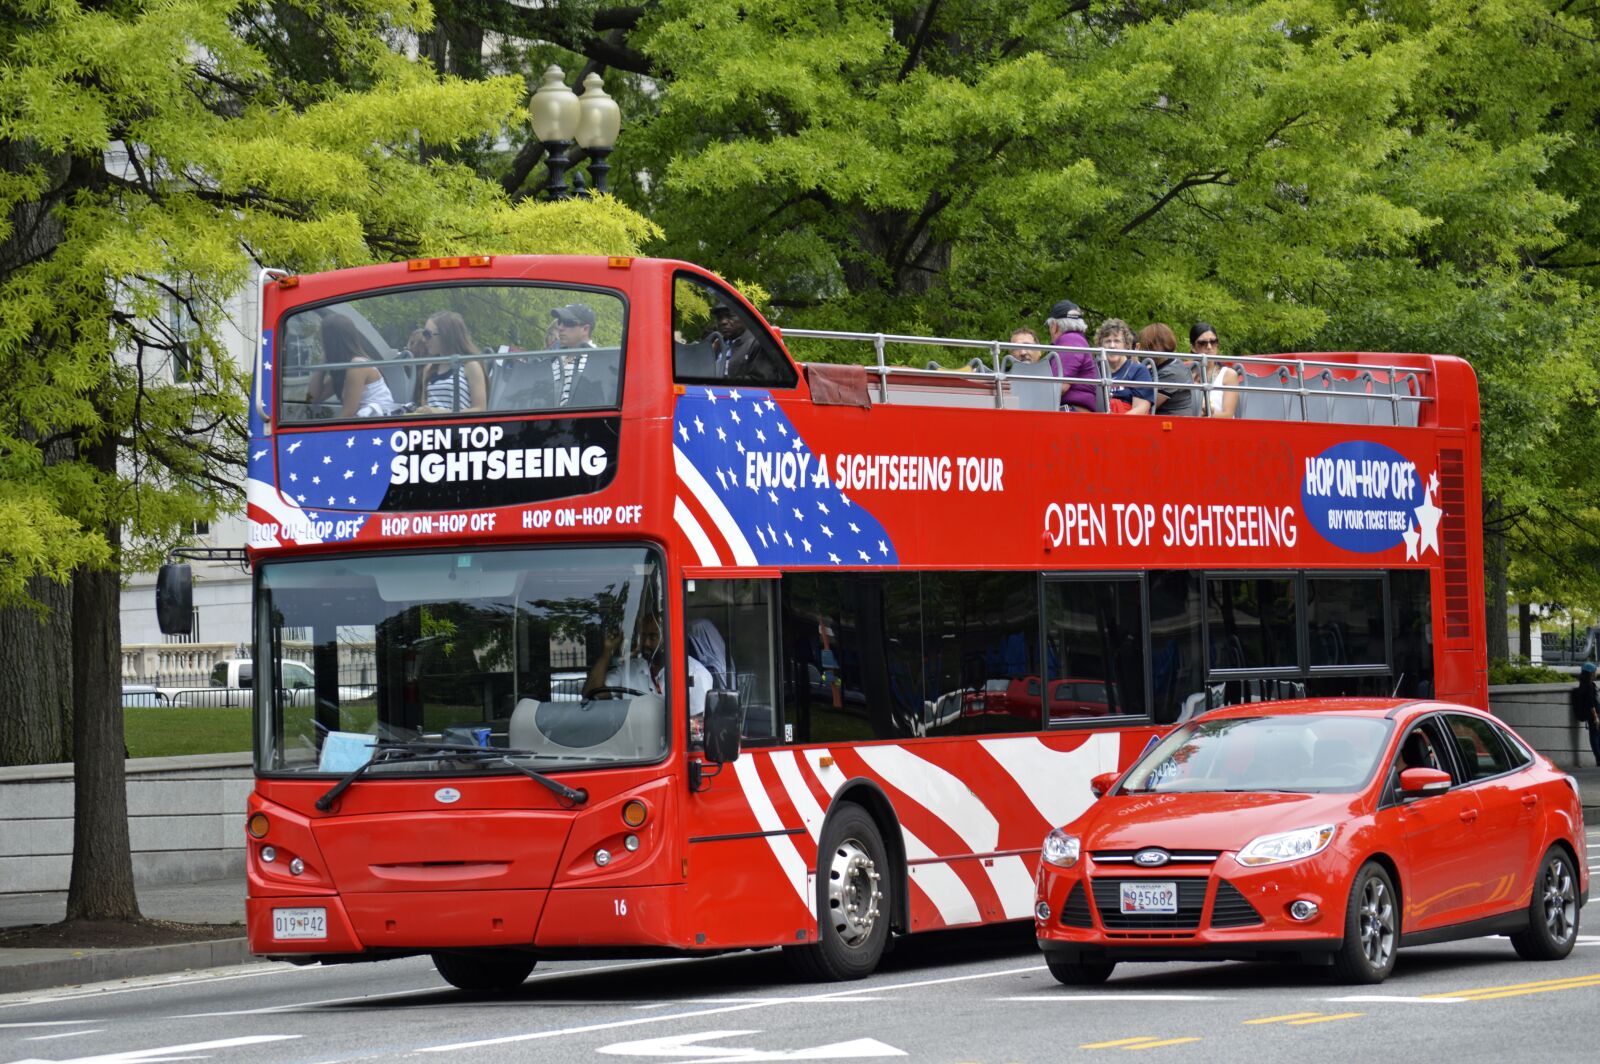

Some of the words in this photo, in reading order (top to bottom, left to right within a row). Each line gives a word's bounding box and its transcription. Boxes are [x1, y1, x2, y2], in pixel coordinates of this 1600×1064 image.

[390, 429, 451, 452] OPEN
[459, 426, 504, 449] TOP
[390, 445, 608, 485] SIGHTSEEING
[745, 452, 811, 489] ENJOY
[815, 453, 830, 489] A
[835, 454, 952, 492] SIGHTSEEING
[957, 457, 1004, 492] TOUR
[1305, 457, 1335, 497] HOP
[1336, 458, 1390, 499] ON-HOP
[1391, 461, 1416, 500] OFF
[381, 517, 409, 536] HOP
[412, 514, 468, 534] ON-HOP
[470, 512, 497, 531] OFF
[522, 509, 552, 529] HOP
[555, 506, 612, 527] ON-HOP
[615, 504, 643, 524] OFF
[1044, 502, 1107, 548] OPEN
[1112, 503, 1156, 547] TOP
[1162, 503, 1297, 548] SIGHTSEEING
[1328, 508, 1343, 530] BUY
[1343, 509, 1364, 530] YOUR
[1364, 509, 1388, 530] TICKET
[1388, 510, 1406, 531] HERE
[251, 522, 279, 542] HOP
[336, 519, 361, 538] OFF
[614, 899, 627, 916] 16
